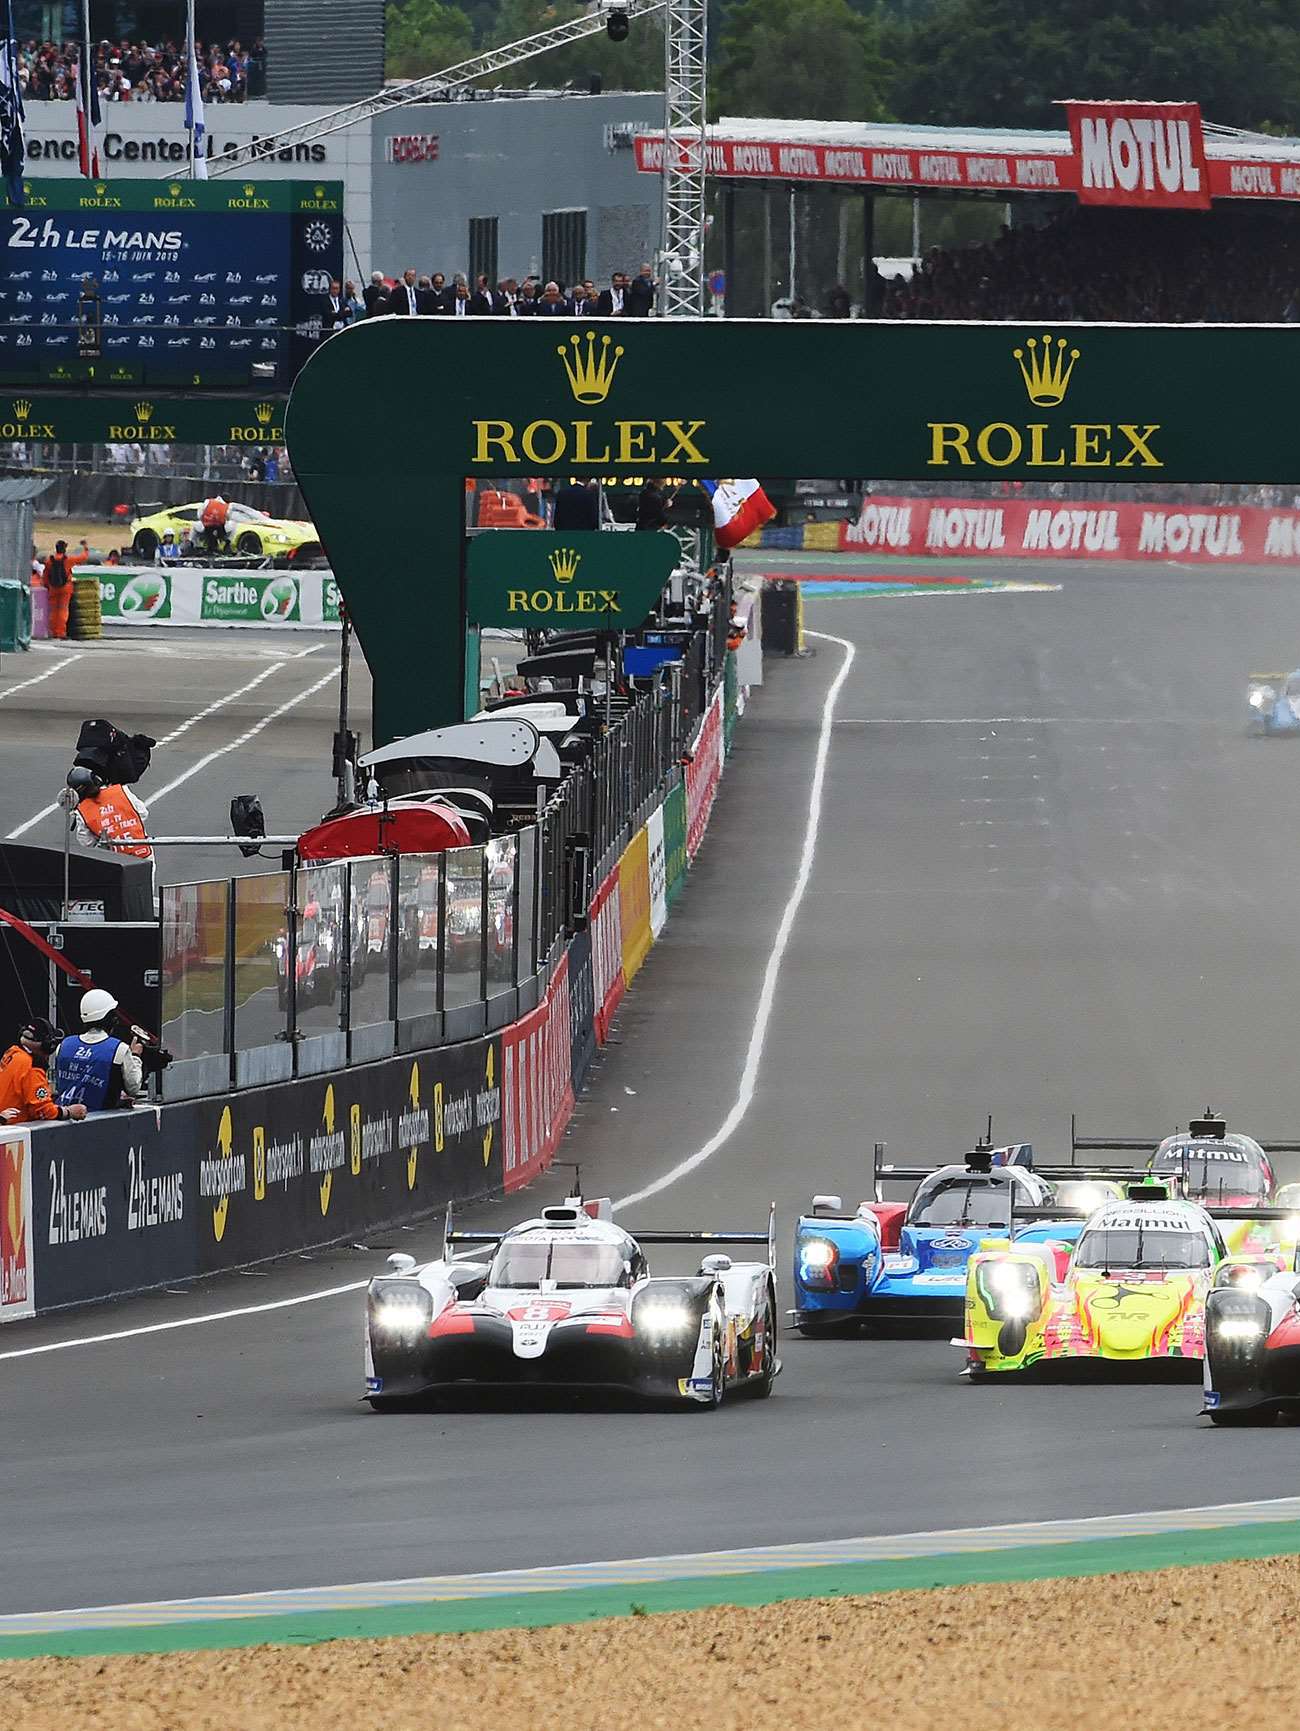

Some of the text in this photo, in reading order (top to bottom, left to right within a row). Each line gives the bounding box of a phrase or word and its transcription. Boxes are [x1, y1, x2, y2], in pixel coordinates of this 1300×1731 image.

[733, 145, 773, 173] MOTUL
[825, 151, 866, 177] MOTUL
[1082, 118, 1200, 192] MOTUL
[1231, 165, 1275, 194] MOTUL
[80, 197, 337, 208] ROLEX ROLEX ROLEX ROLEX
[65, 230, 100, 248] LE
[103, 230, 182, 249] MANS
[0, 424, 283, 440] OLEX ROLEX ROLE
[471, 420, 710, 463] ROLEX
[926, 423, 1165, 466] ROLEX
[926, 508, 1005, 549] MOTUL
[1023, 510, 1120, 551] MOTUL
[1138, 512, 1243, 555] MOTUL
[205, 580, 258, 604] Sarthe
[506, 590, 621, 613] ROLEX
[81, 1187, 107, 1239] MANS
[159, 1173, 184, 1223] MANS
